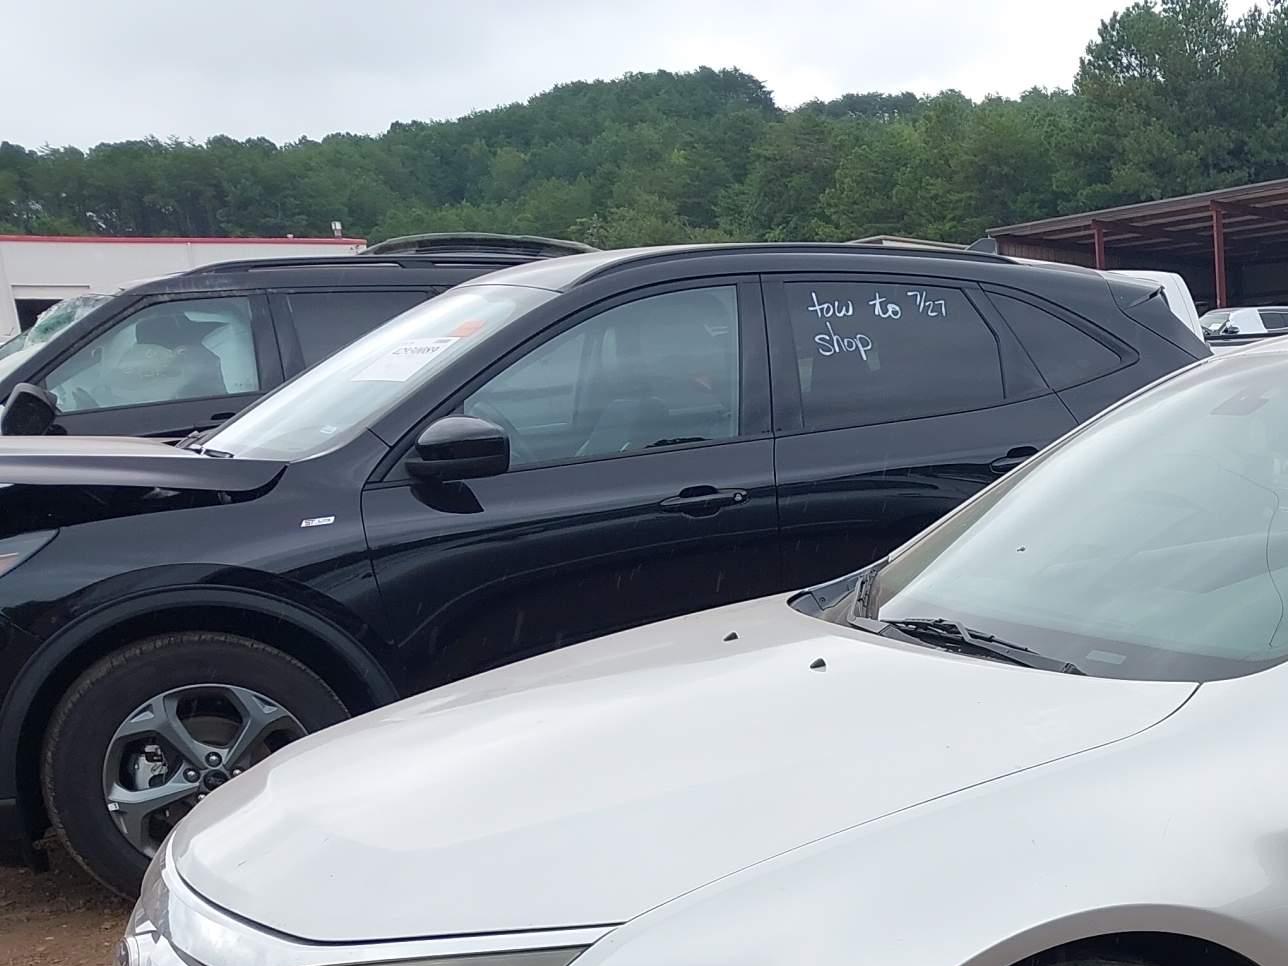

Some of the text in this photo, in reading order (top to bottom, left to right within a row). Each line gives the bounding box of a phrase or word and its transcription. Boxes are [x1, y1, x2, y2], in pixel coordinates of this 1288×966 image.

[807, 290, 948, 320] tow to 7/27
